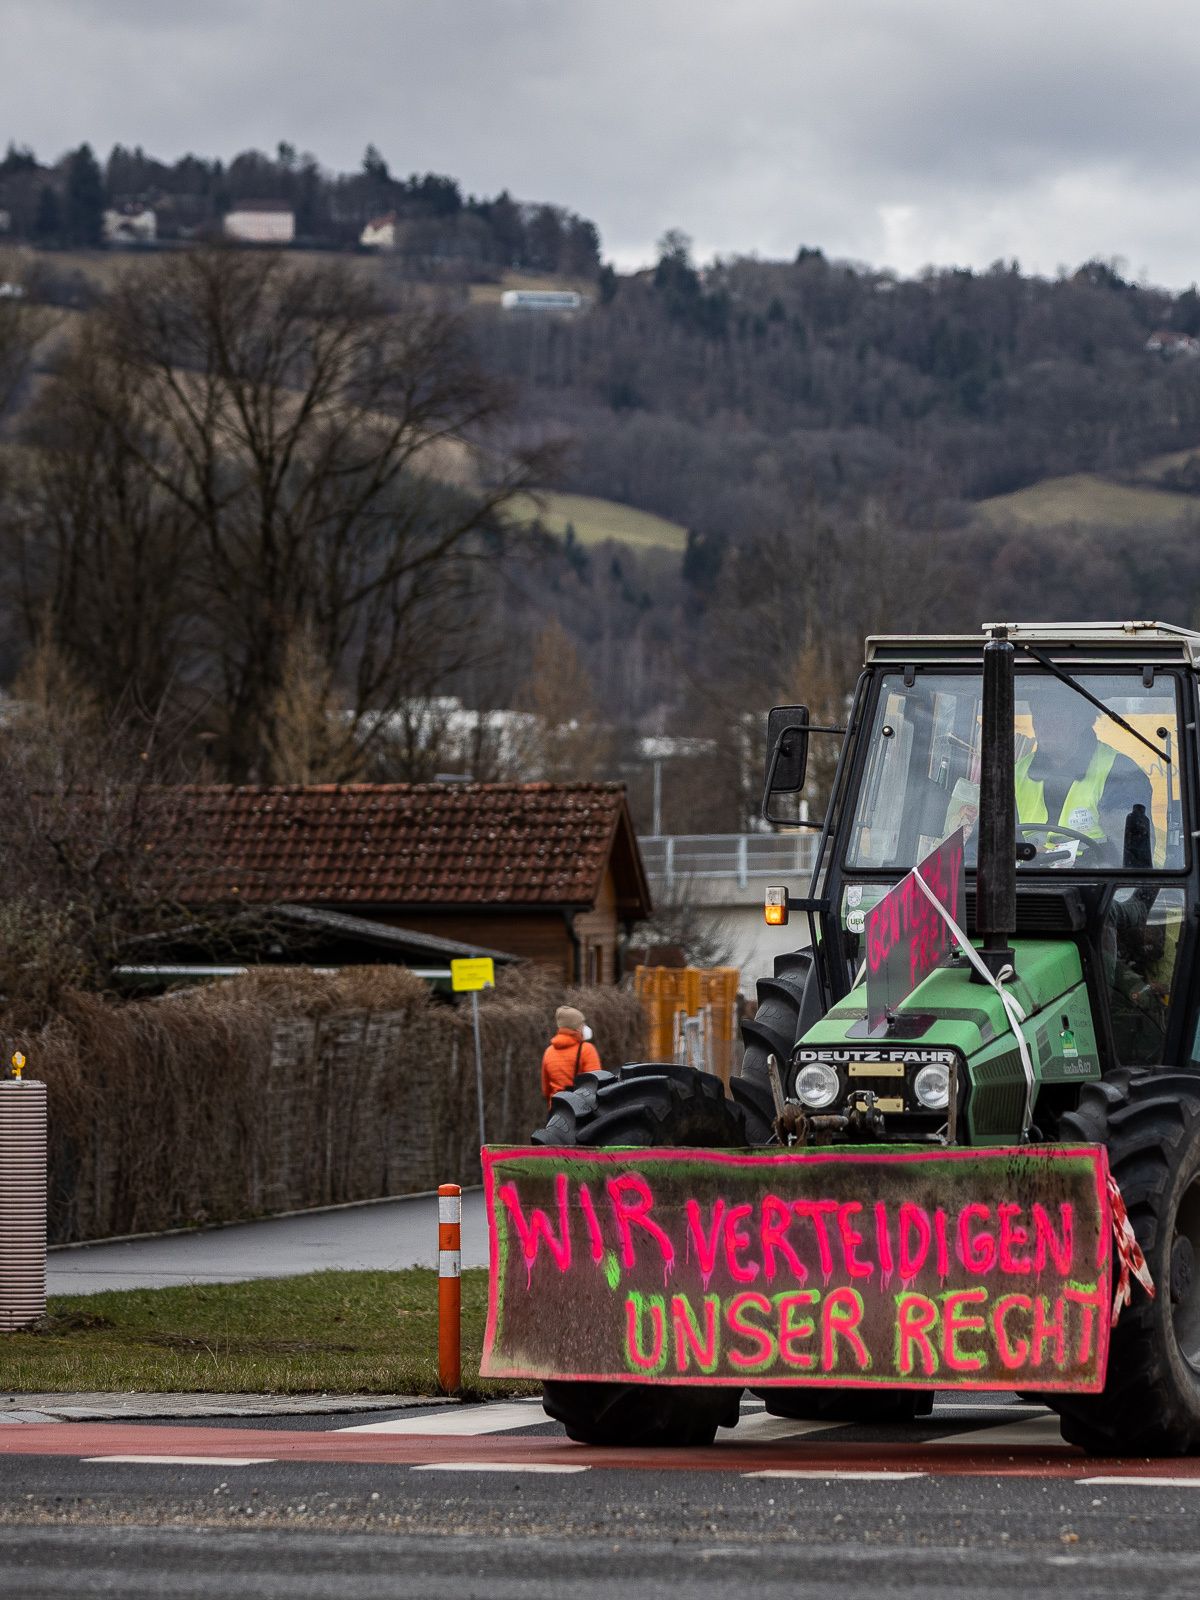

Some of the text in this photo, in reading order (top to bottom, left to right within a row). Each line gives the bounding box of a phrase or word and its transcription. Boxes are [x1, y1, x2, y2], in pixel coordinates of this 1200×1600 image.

[800, 1051, 954, 1062] DEUTZ-FAHR
[500, 1172, 1073, 1282] WIR VERTEIDIGEN
[624, 1282, 1098, 1376] UNSER RECHT
